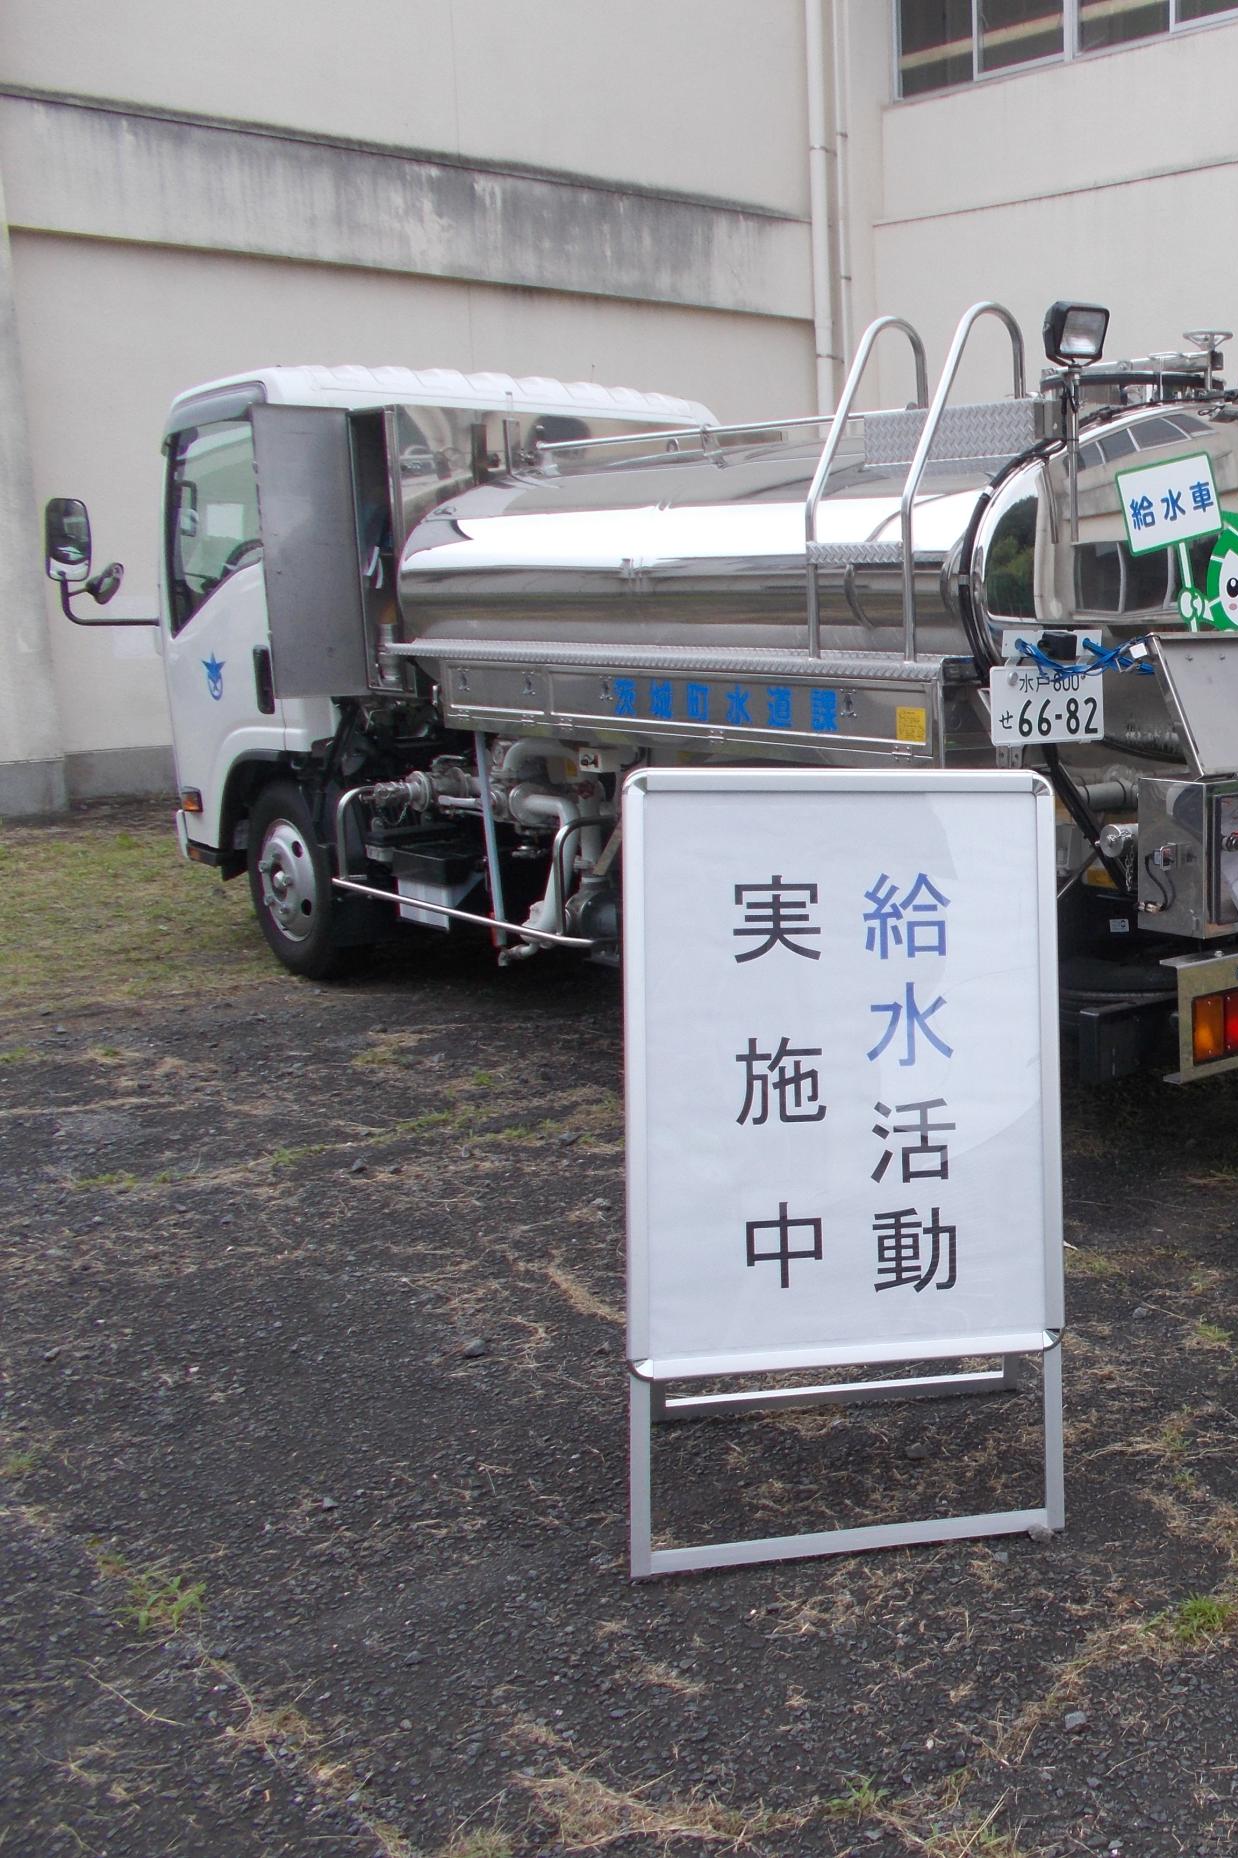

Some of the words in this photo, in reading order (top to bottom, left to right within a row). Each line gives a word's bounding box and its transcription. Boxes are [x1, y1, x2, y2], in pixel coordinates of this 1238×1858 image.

[1129, 481, 1215, 531] 給水車
[1018, 697, 1099, 737] 66-82
[733, 875, 827, 1289] 実施中
[863, 873, 958, 1293] 給水活動
